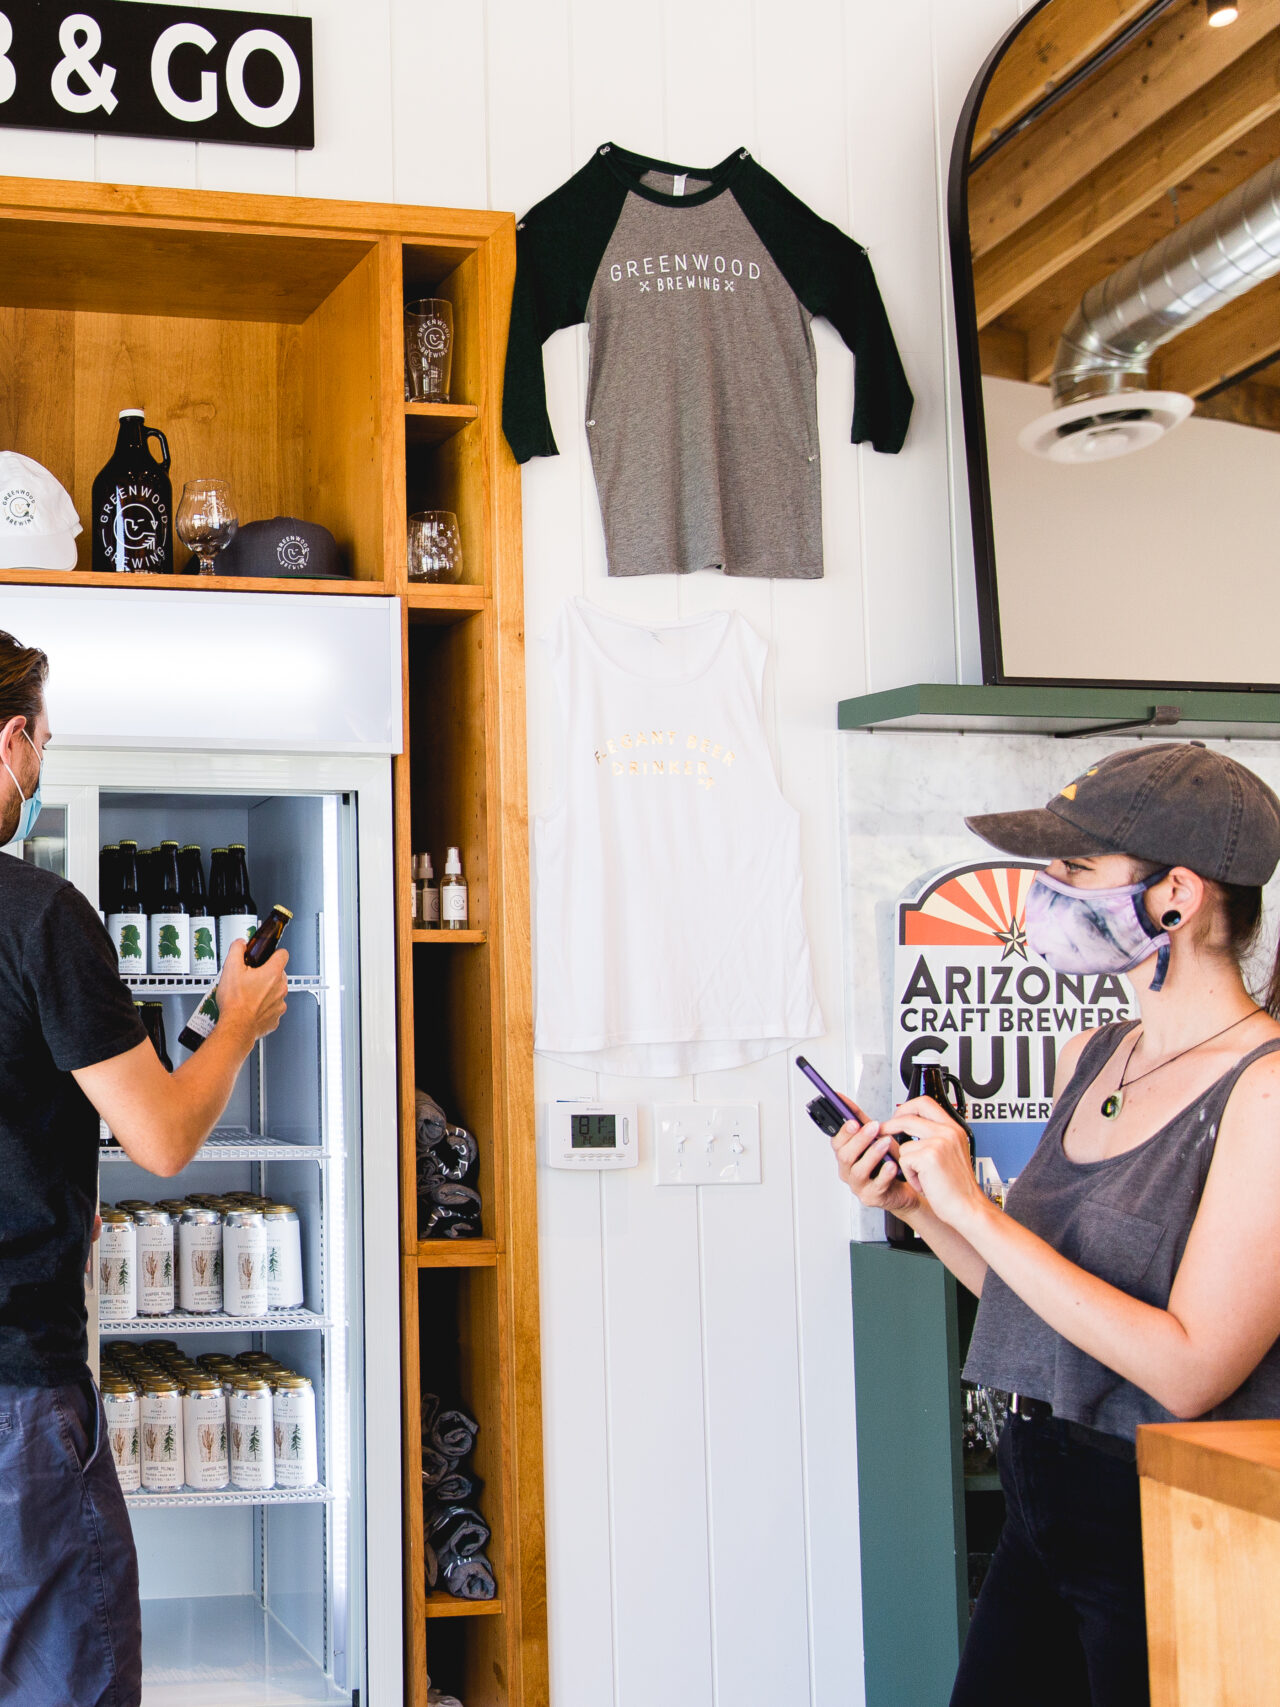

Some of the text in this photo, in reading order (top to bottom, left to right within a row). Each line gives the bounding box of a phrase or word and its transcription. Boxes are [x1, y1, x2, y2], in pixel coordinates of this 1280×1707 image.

[51, 14, 118, 116] &
[150, 22, 301, 129] GO
[610, 254, 761, 282] GREENWOOD
[657, 275, 720, 292] BREWING
[416, 319, 450, 338] GREENWOOD
[2, 489, 36, 506] GREENWOOD
[100, 484, 168, 524] GREENWOOD
[6, 514, 34, 526] BREWING
[276, 535, 310, 552] GREENWOOD
[104, 545, 165, 569] BREWING
[687, 734, 736, 767] BEER
[612, 760, 709, 776] DRINKER
[901, 953, 1130, 1005] ARIZONA
[900, 1008, 1130, 1032] CRAFT BREWERS
